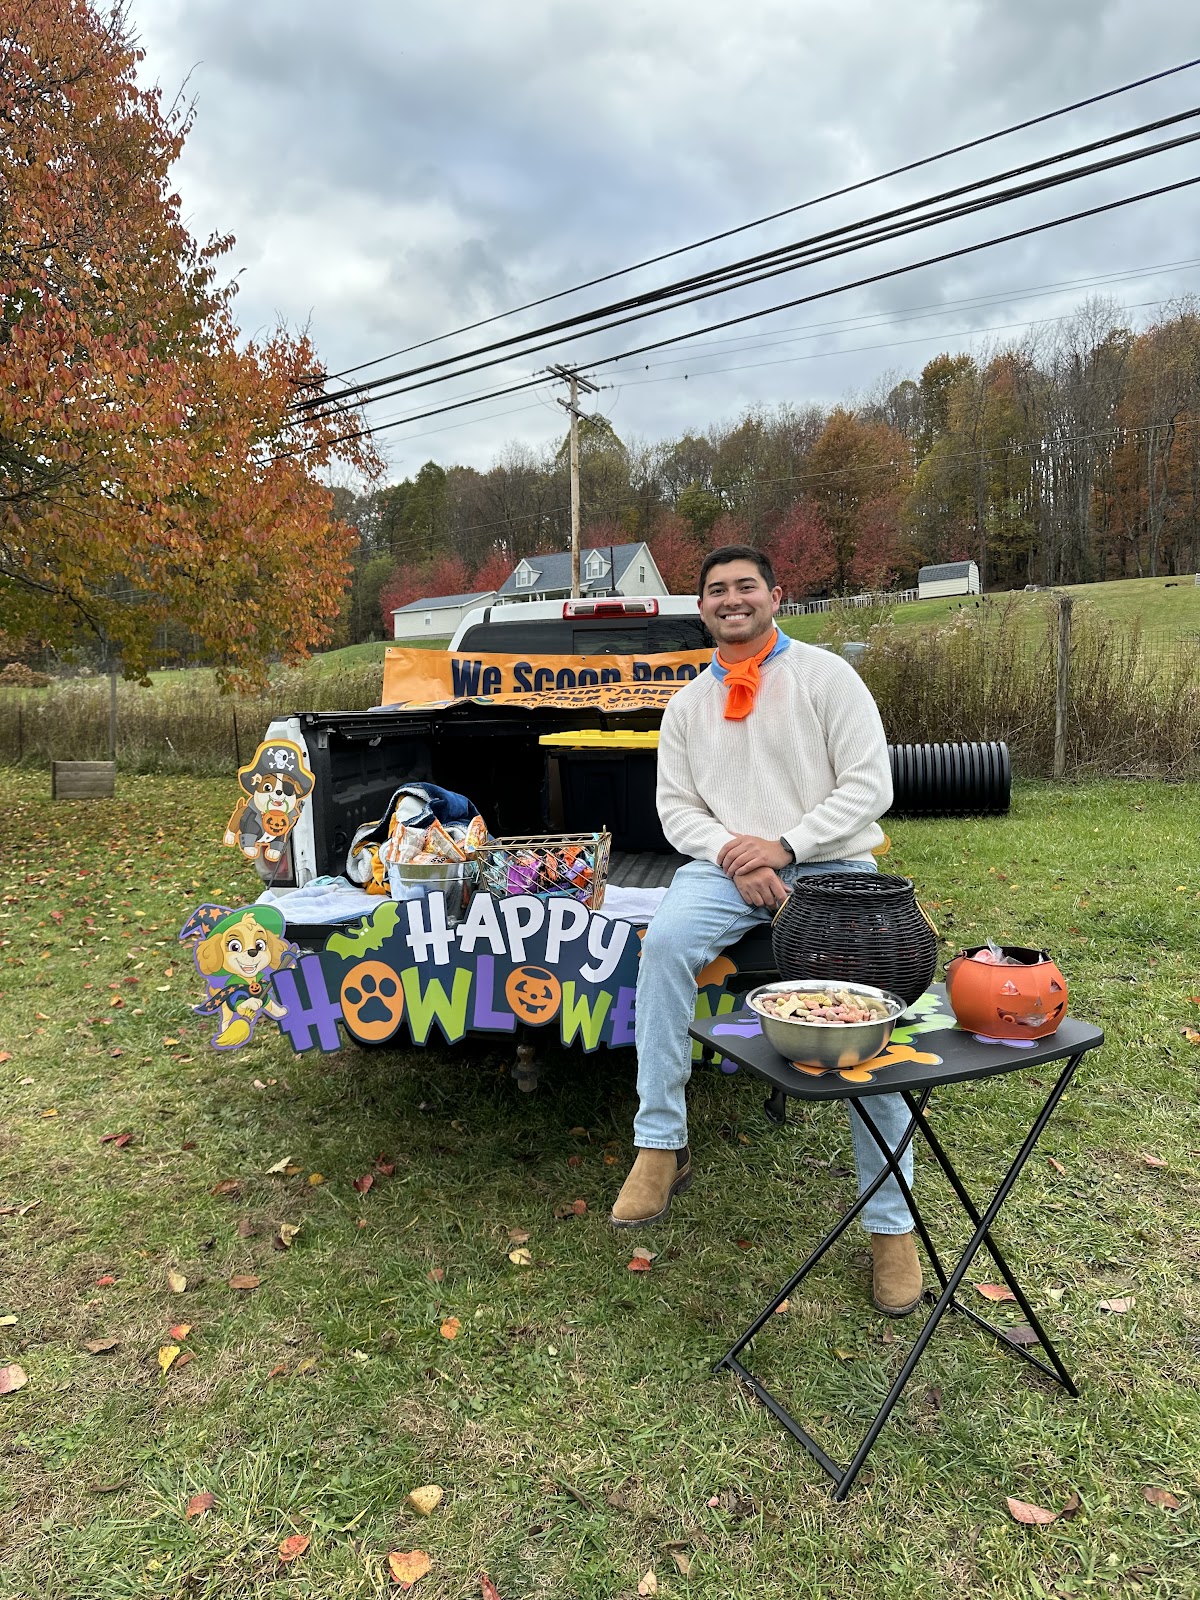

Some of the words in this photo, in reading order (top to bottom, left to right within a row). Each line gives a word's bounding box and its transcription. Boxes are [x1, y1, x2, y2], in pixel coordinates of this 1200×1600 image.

[451, 658, 502, 698] We
[633, 661, 711, 682] Poo
[531, 687, 681, 698] MOUNTAINE
[607, 695, 671, 704] SCOO
[406, 891, 633, 984] HAPPY
